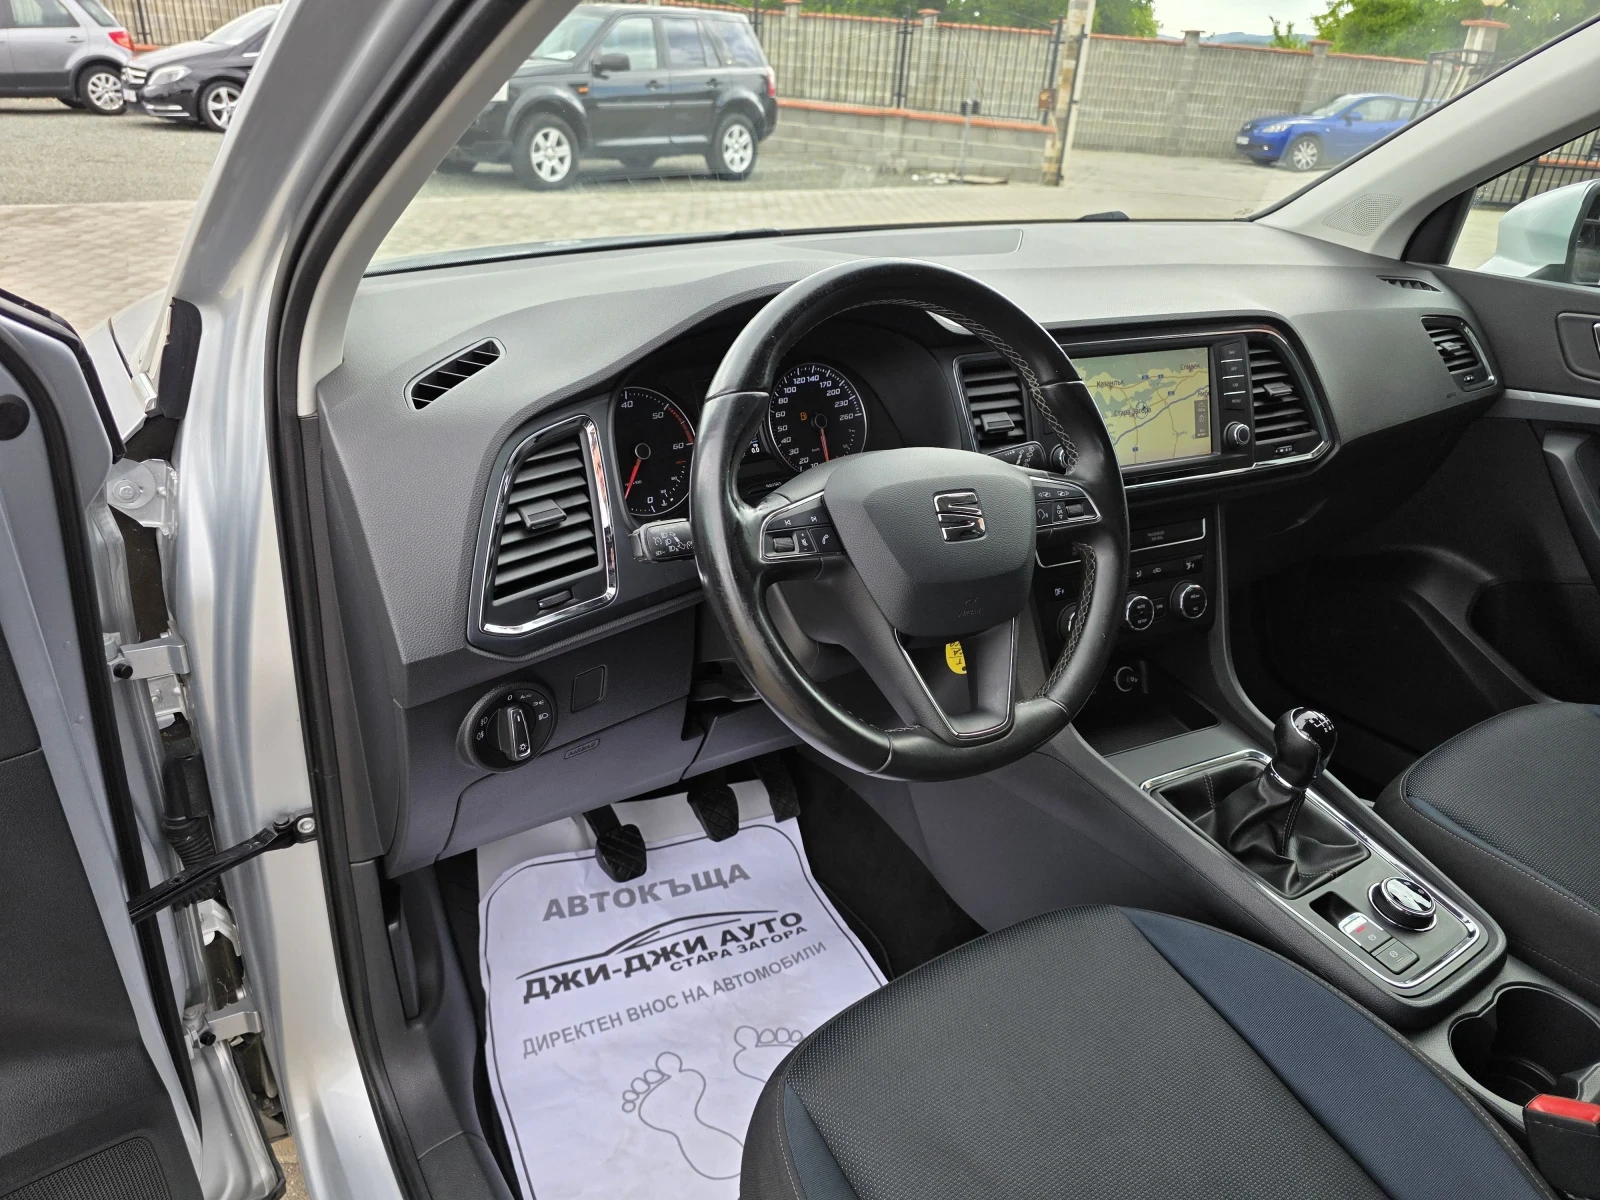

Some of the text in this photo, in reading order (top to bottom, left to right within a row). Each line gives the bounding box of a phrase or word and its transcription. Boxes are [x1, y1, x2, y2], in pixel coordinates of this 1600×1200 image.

[793, 376, 806, 385] 120
[806, 374, 820, 382] 140
[819, 380, 832, 389] 170
[783, 386, 797, 394] 100
[826, 388, 841, 397] 200
[621, 400, 634, 409] 40
[778, 397, 789, 405] 80
[834, 399, 849, 408] 230
[652, 411, 665, 420] 50
[775, 410, 786, 418] 60
[839, 412, 854, 421] 260
[777, 424, 788, 433] 50
[780, 436, 792, 444] 40
[672, 442, 685, 450] 60
[751, 446, 760, 454] 0.0
[789, 447, 799, 456] 30
[799, 457, 809, 465] 20
[647, 496, 654, 504] 0
[542, 863, 752, 922] АВТОКЪЩА
[669, 925, 808, 972] СТАРА ЗАГОРА
[523, 911, 804, 1004] ДЖИ-ДЖИ АУТО
[522, 940, 828, 1059] ДИРЕКТЕН ВНОС НА АВТОМОБИЛИ
